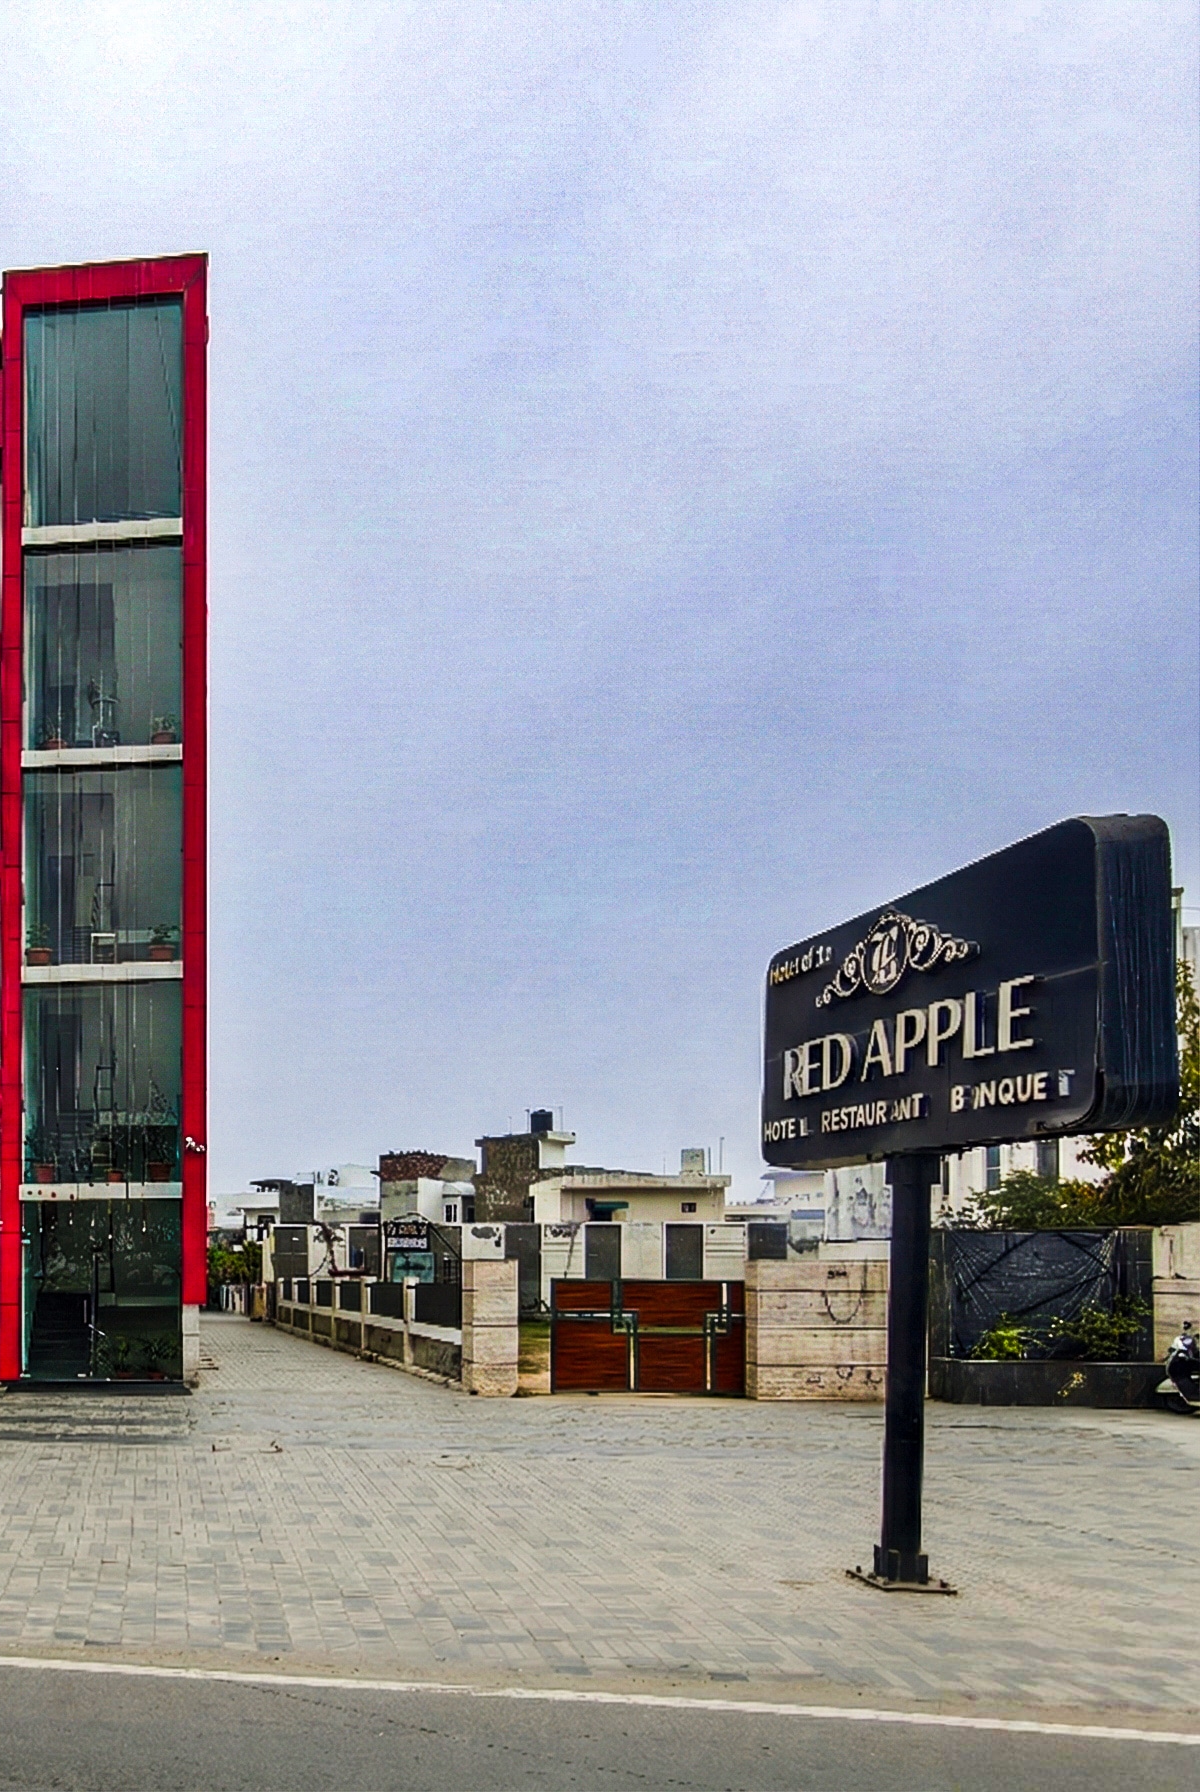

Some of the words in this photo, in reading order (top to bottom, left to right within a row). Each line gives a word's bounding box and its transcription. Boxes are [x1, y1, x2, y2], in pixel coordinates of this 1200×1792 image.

[784, 1033, 851, 1101] RED
[860, 975, 1034, 1083] APPLE
[763, 1117, 811, 1142] HOTEL
[821, 1092, 925, 1133] RESTAURANT
